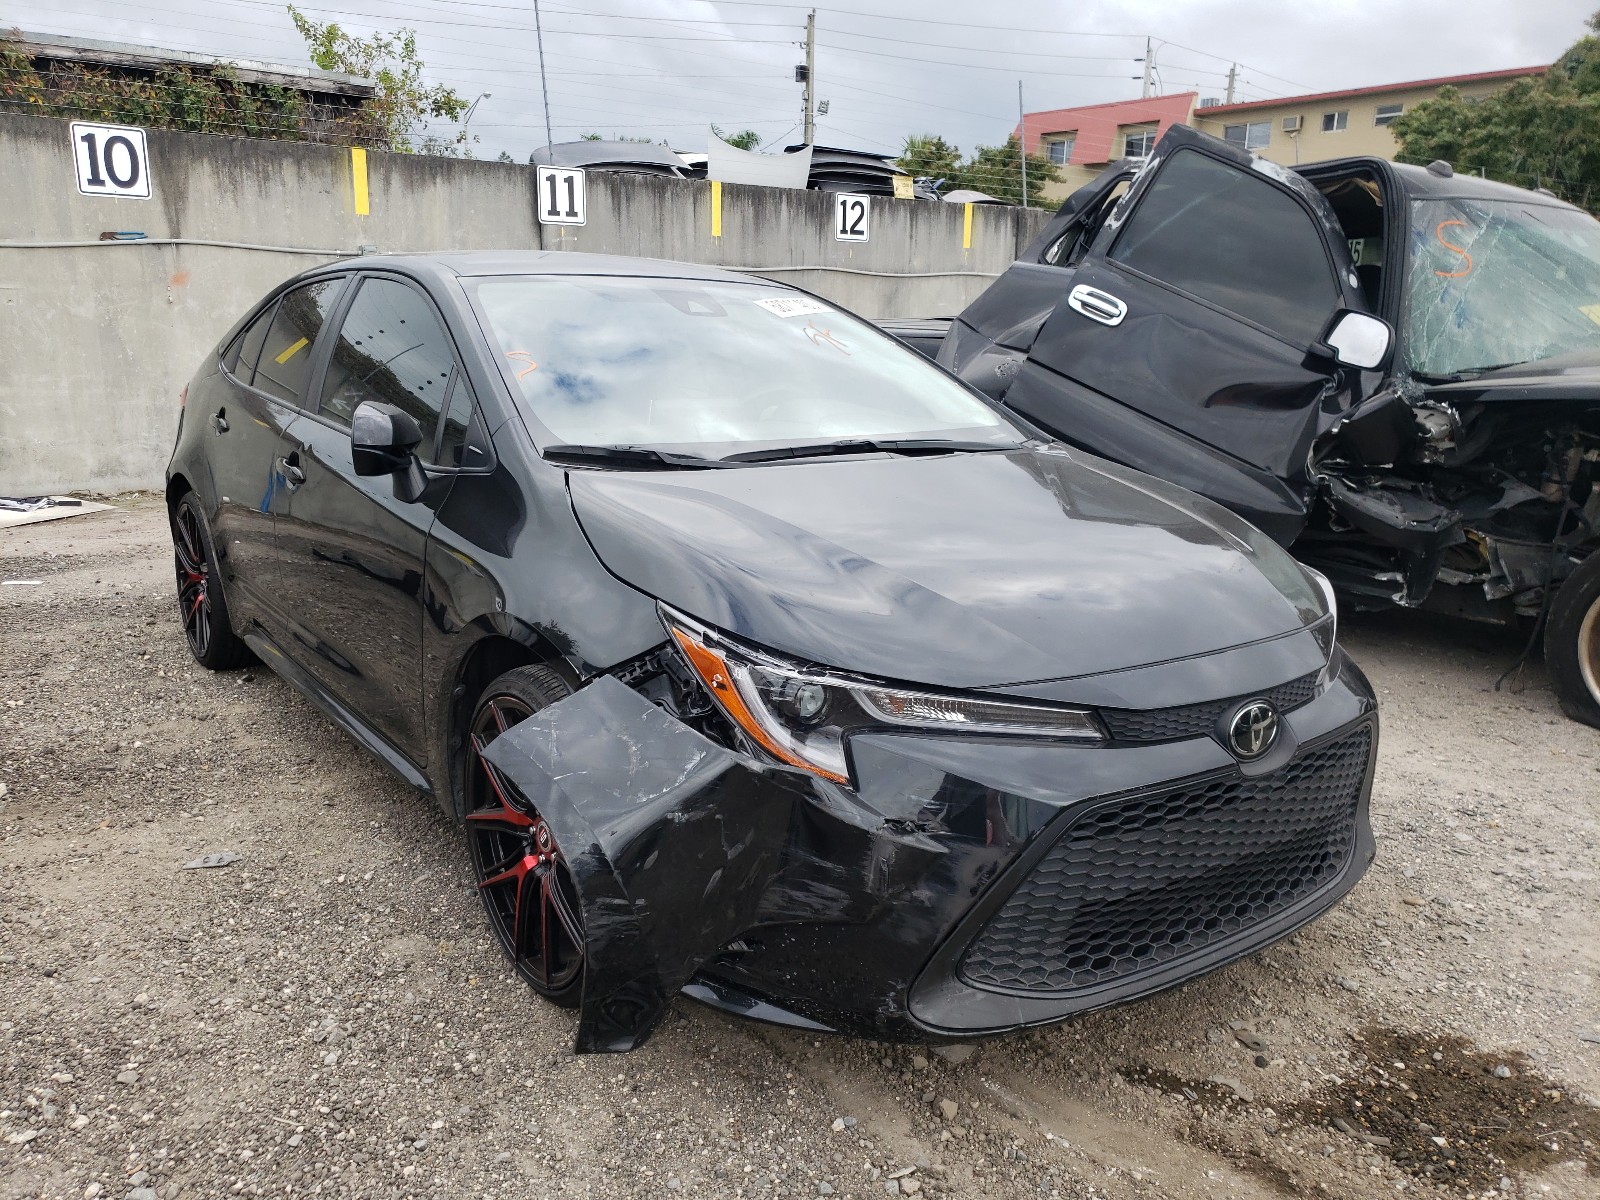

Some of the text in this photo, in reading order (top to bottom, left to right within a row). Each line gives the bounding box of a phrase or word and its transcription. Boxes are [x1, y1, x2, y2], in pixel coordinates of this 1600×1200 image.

[81, 133, 139, 188] 10
[546, 174, 578, 217] 11
[840, 200, 865, 236] 12
[1434, 220, 1472, 278] S
